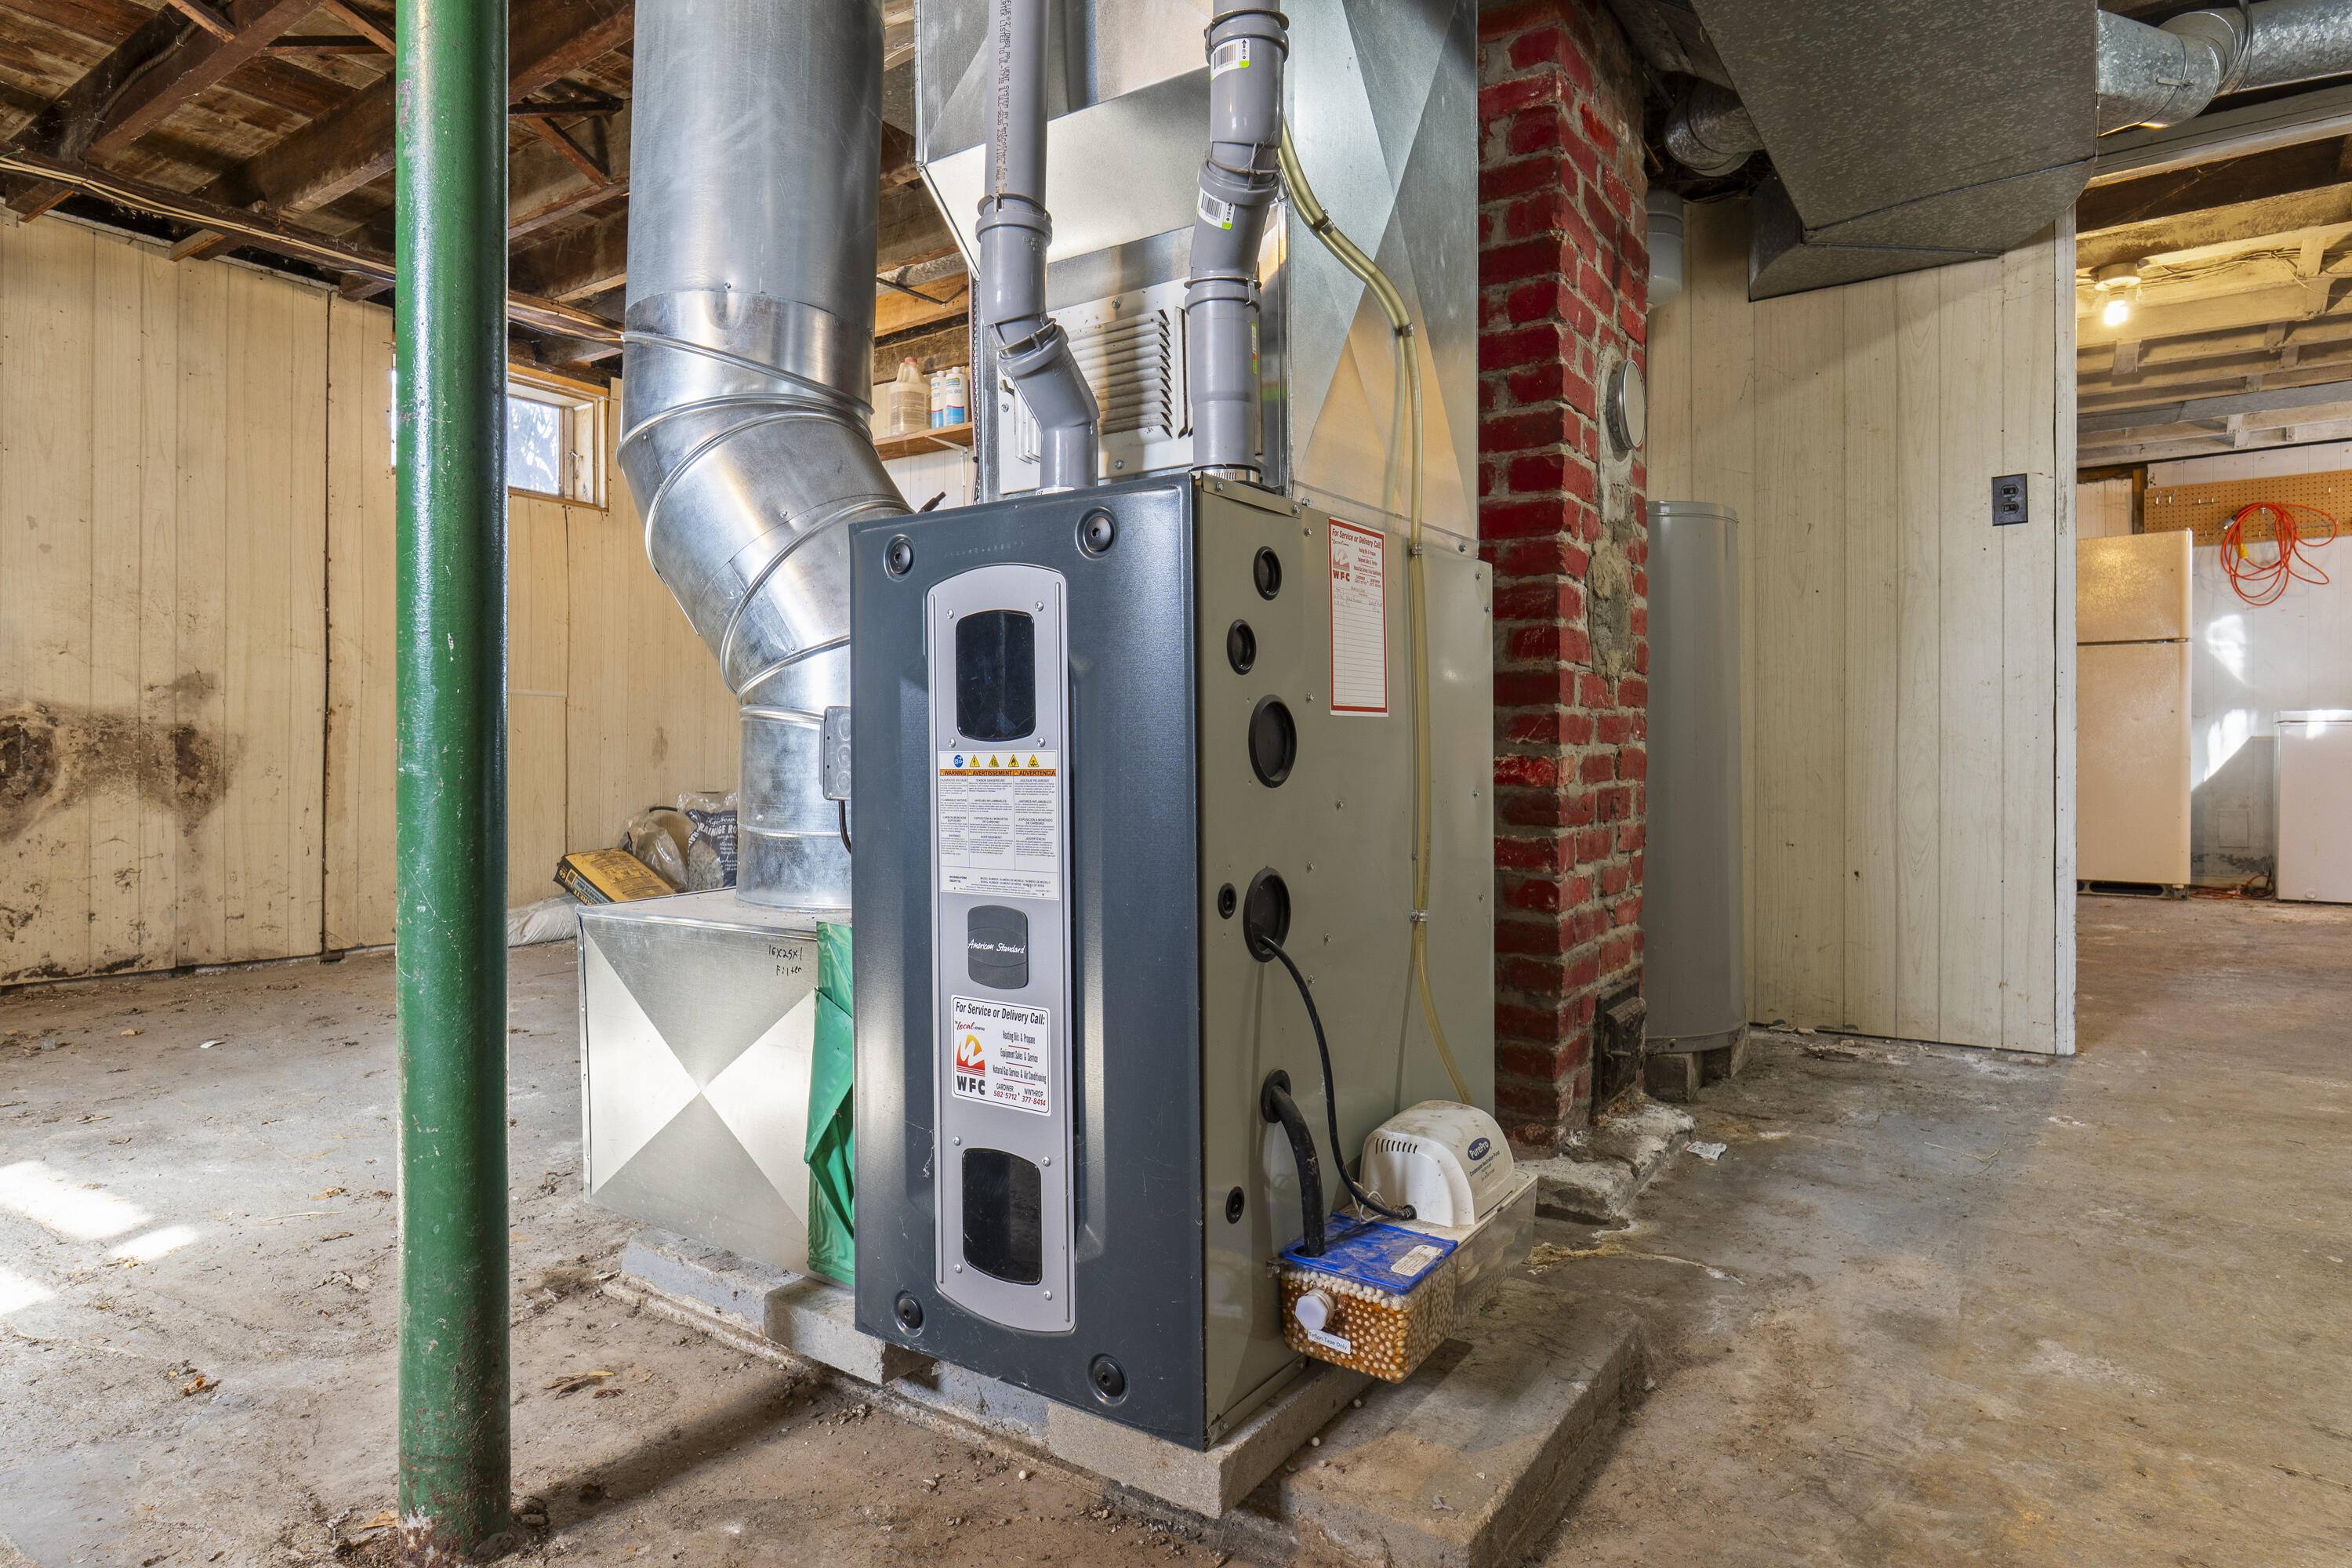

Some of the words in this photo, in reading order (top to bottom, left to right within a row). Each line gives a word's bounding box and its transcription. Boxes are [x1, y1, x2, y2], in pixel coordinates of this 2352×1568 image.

[1339, 530, 1353, 541] Service
[1359, 535, 1373, 548] Delivery
[1333, 569, 1350, 582] WFC
[967, 938, 994, 950] American
[996, 942, 1025, 954] Standard
[776, 964, 802, 976] Filter
[956, 1001, 966, 1013] For
[967, 1003, 991, 1017] Service
[993, 1009, 1000, 1018] or
[1001, 1008, 1029, 1025] Delivery
[1030, 1012, 1045, 1025] Call:
[956, 1021, 975, 1030] local
[1003, 1030, 1014, 1043] Heating
[1020, 1033, 1023, 1042] &
[1023, 1033, 1036, 1045] Propane
[1000, 1048, 1015, 1061] Equipment
[1024, 1052, 1026, 1061] &
[1027, 1053, 1039, 1063] Service
[993, 1065, 1003, 1075] Natural
[1009, 1068, 1019, 1078] Service
[1020, 1069, 1023, 1079] &
[1029, 1071, 1047, 1085] Conditioning
[956, 1076, 985, 1095] WFC
[996, 1083, 1014, 1092] GARDINER
[1024, 1088, 1044, 1098] WINTHROP
[993, 1090, 1017, 1100] 582-5712
[1022, 1095, 1046, 1106] 377-8414
[1468, 1141, 1489, 1159] PurePro
[1309, 1332, 1323, 1341] Teflon
[1336, 1341, 1348, 1350] Only
